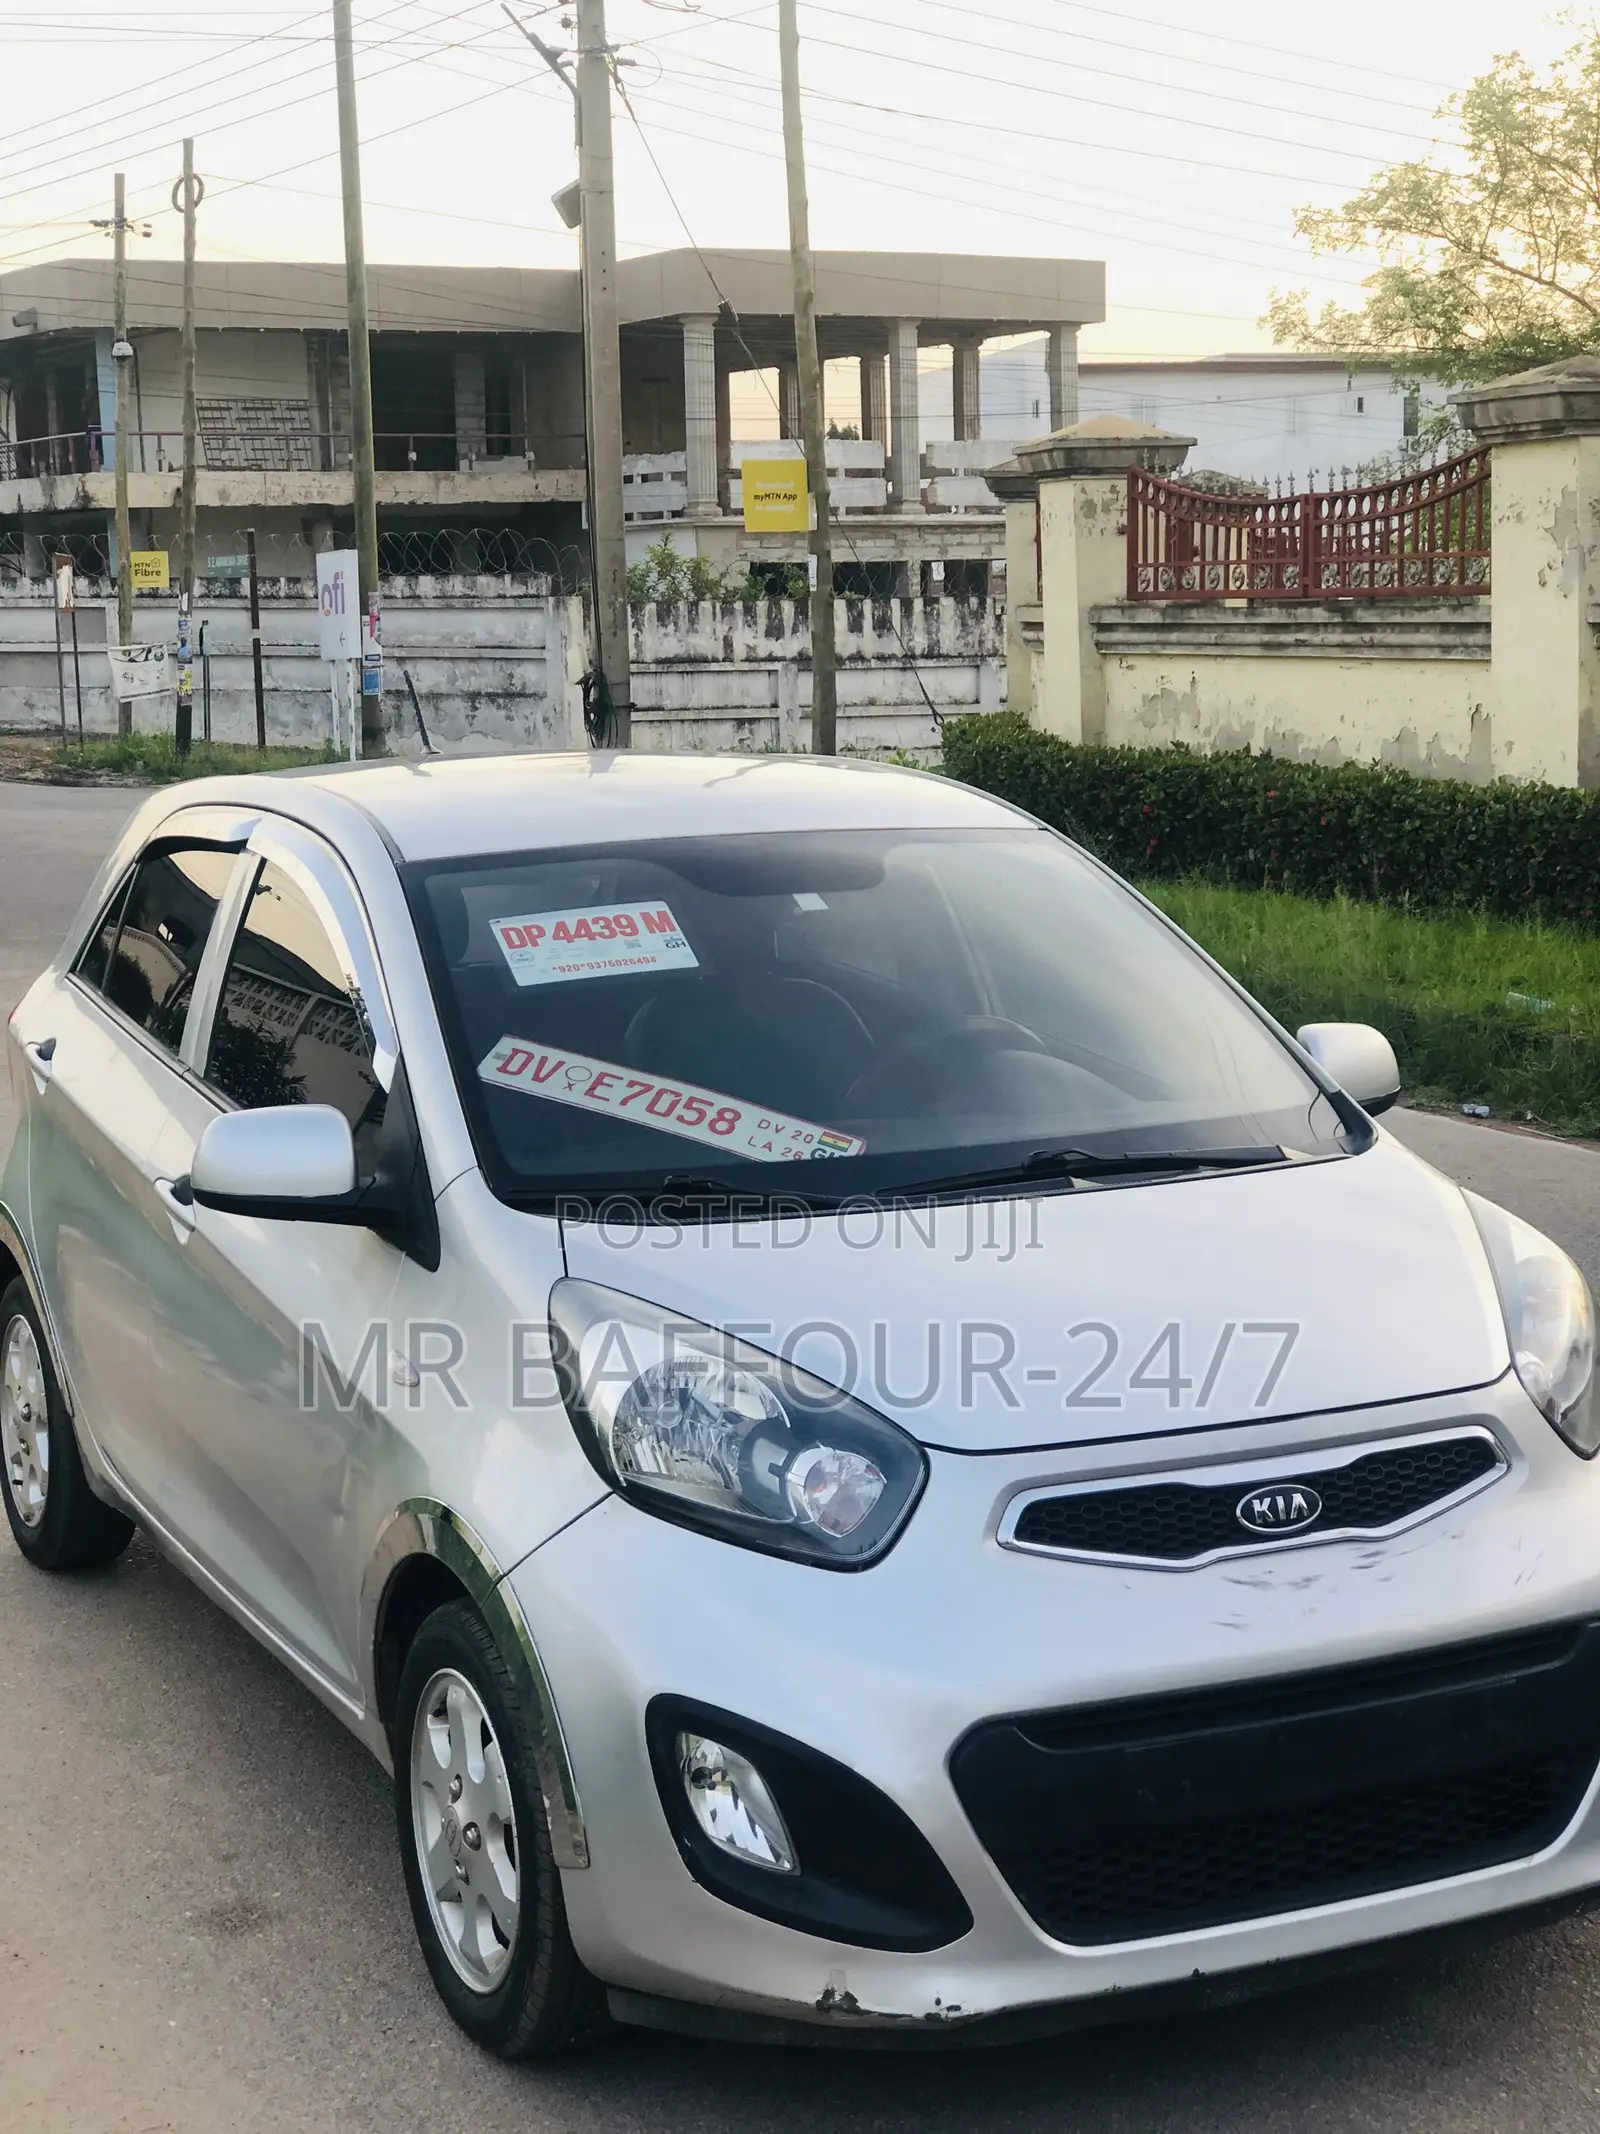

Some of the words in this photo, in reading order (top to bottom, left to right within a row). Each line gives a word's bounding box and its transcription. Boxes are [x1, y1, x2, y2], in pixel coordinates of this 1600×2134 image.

[753, 492, 782, 502] myMTN
[782, 493, 798, 502] App
[134, 568, 161, 577] Fibre
[500, 923, 546, 950] DP
[552, 913, 640, 944] 4439
[639, 910, 678, 935] M
[665, 940, 687, 949] GH
[496, 1047, 566, 1083] DV
[584, 1071, 742, 1136] E7058
[757, 1118, 786, 1134] DV
[791, 1129, 814, 1144] 20
[747, 1136, 773, 1152] LA
[781, 1147, 804, 1160] 26
[1251, 1492, 1311, 1525] KIA
